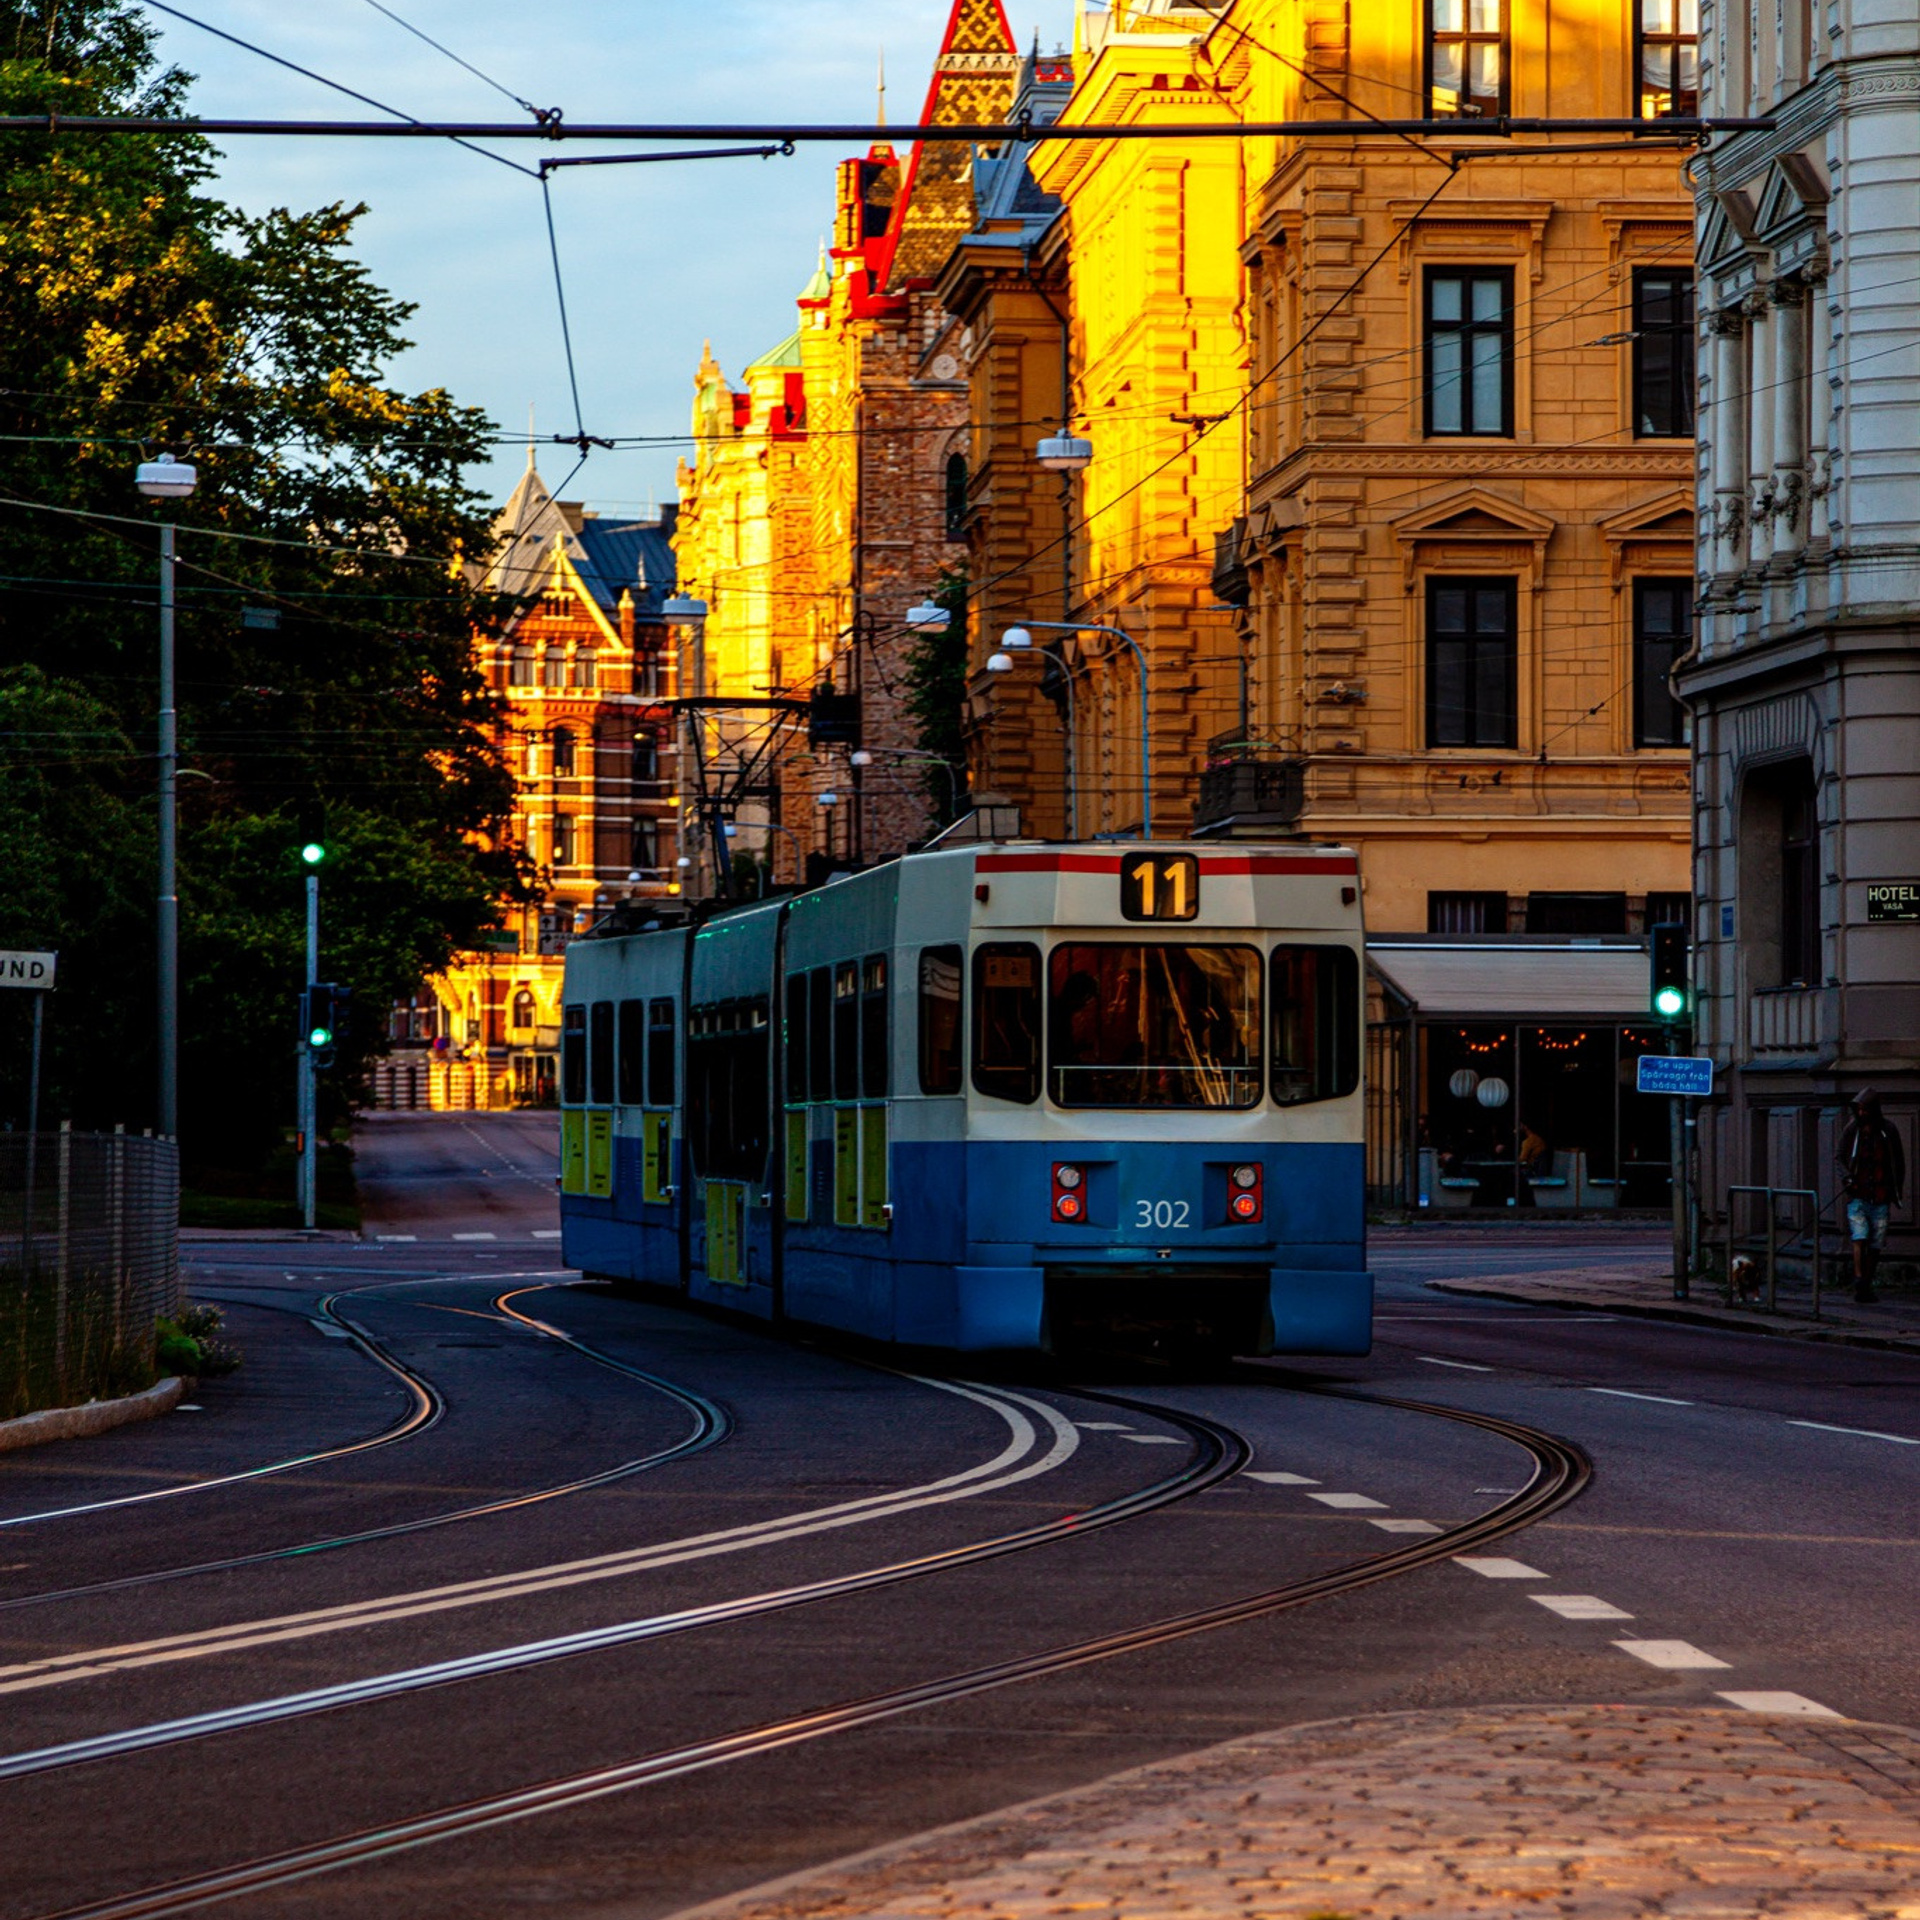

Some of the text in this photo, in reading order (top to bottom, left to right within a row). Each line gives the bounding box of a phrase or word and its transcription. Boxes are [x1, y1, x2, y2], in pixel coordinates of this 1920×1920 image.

[1131, 861, 1186, 916] 11
[1869, 886, 1919, 901] HOTEL
[1135, 1199, 1190, 1228] 302
